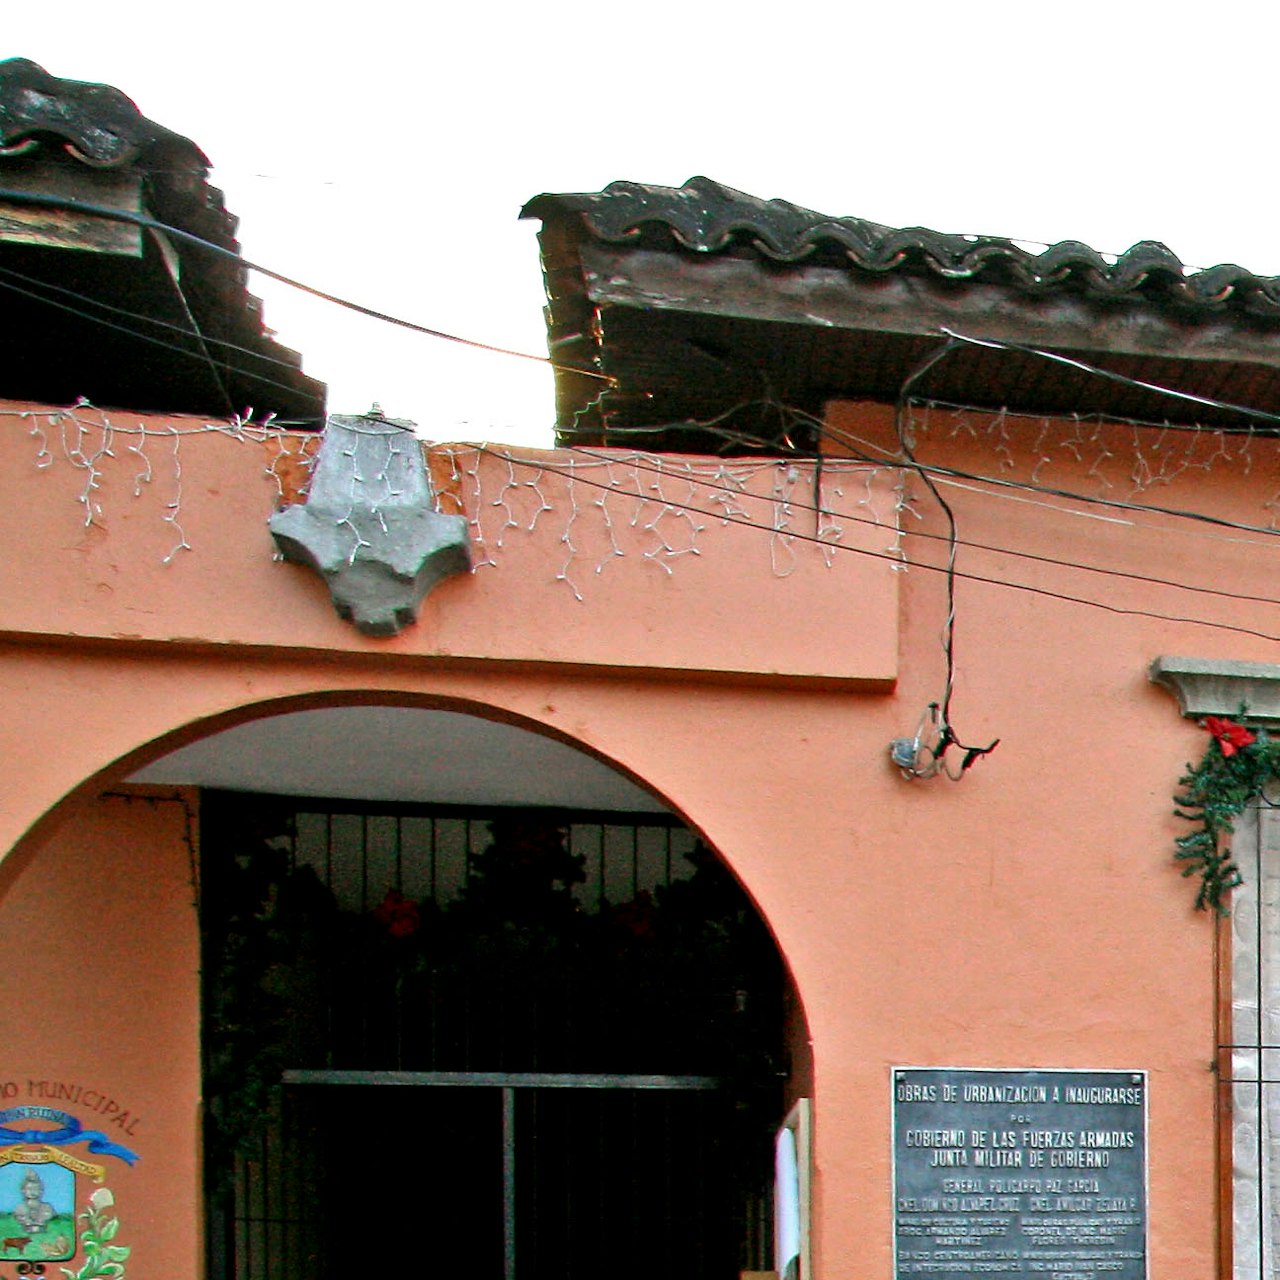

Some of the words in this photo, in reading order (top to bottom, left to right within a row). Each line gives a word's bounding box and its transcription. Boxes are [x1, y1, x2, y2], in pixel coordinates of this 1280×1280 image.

[897, 1085, 937, 1102] OBRAS
[942, 1085, 957, 1102] DE
[964, 1086, 1047, 1104] URBANIZACION
[1052, 1087, 1060, 1103] A
[1066, 1088, 1141, 1105] INAUGURARSE
[27, 1079, 139, 1136] MUNICIPAL
[1010, 1114, 1031, 1124] POR
[906, 1130, 965, 1148] GOBIERNO
[971, 1131, 987, 1148] DE
[993, 1131, 1016, 1148] LAS
[1023, 1131, 1074, 1149] FUERZAS
[1079, 1131, 1134, 1149] ARMADAS
[930, 1150, 968, 1168] JUNTA
[974, 1150, 1022, 1168] MILITAR
[1030, 1151, 1044, 1168] DE
[1051, 1150, 1110, 1168] GOBIERNO
[943, 1178, 984, 1193] GENERAL
